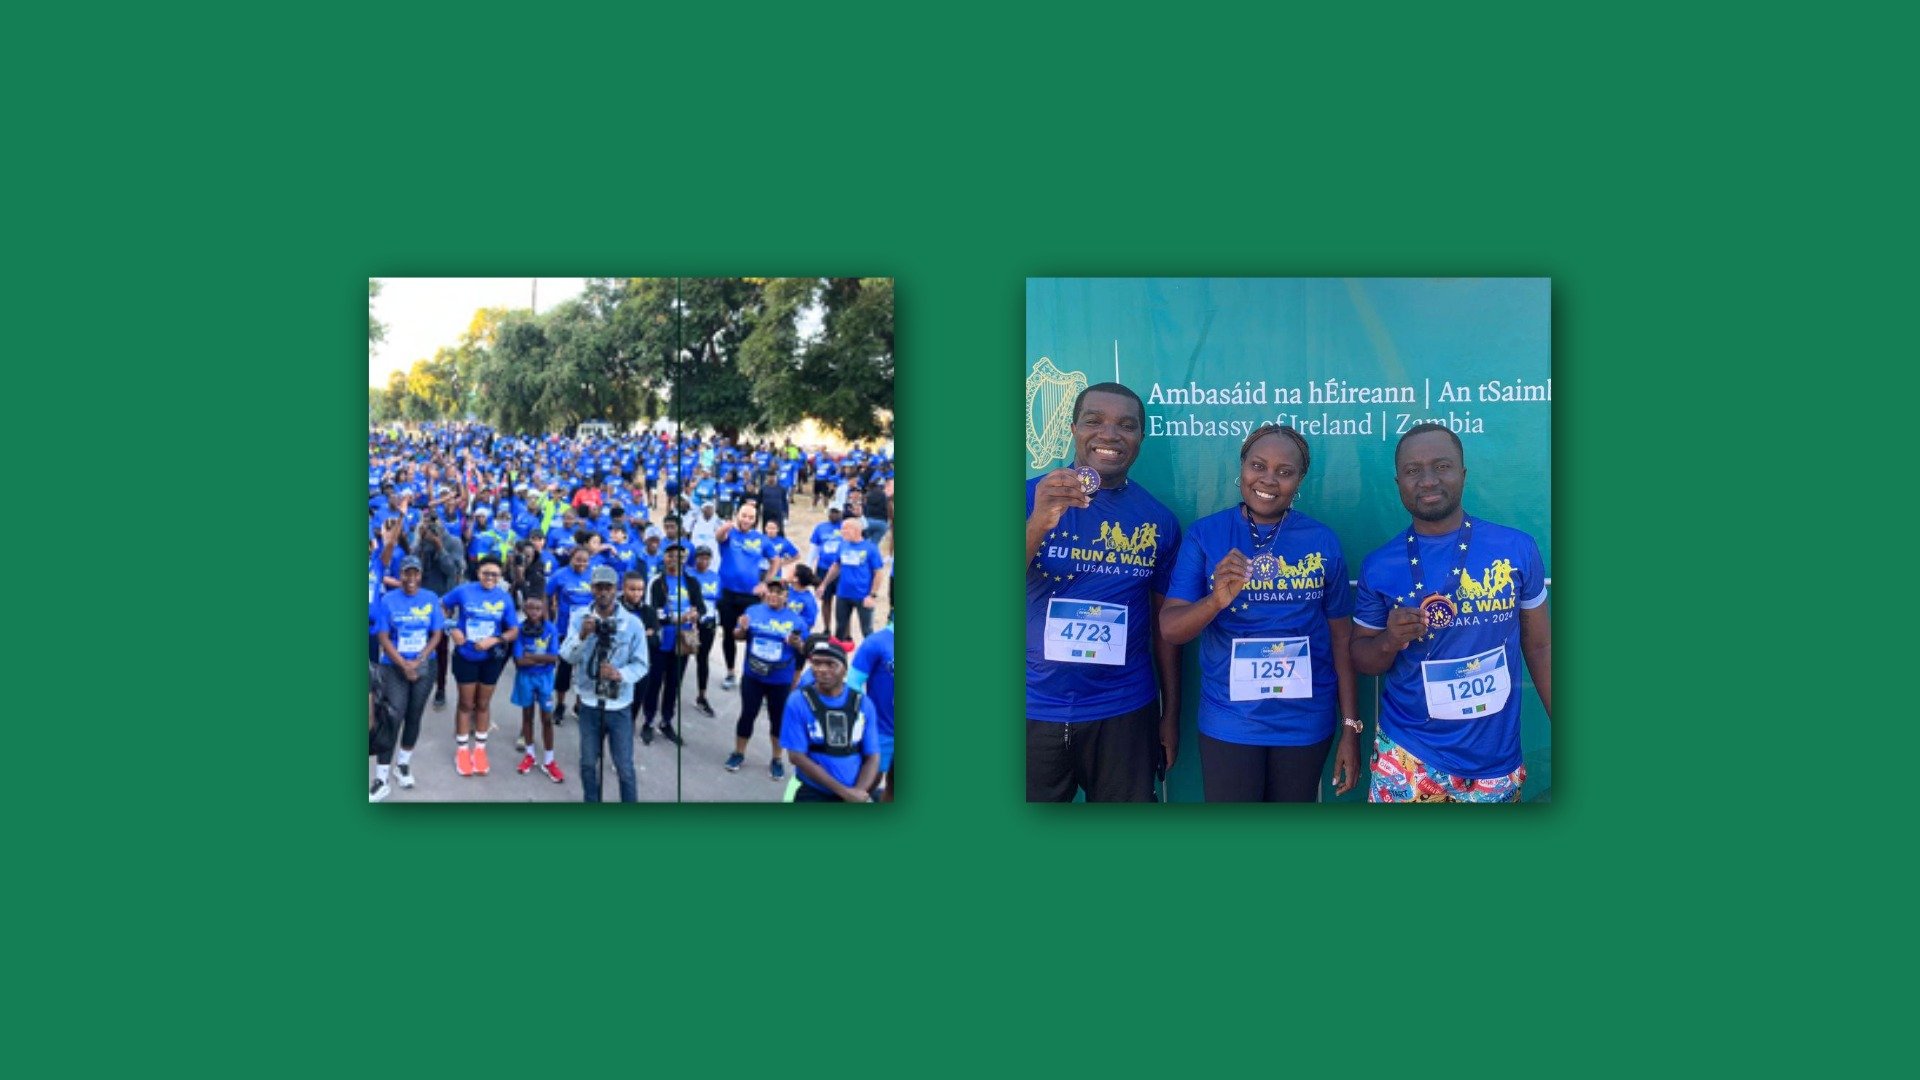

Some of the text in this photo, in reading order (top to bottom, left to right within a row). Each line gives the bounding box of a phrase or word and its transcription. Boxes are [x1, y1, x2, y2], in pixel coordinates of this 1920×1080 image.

[1147, 381, 1267, 405] Ambasáid
[1273, 387, 1302, 404] na
[1308, 378, 1416, 404] hÉireann
[1438, 381, 1472, 402] An
[1149, 413, 1254, 442] Embassy
[1290, 412, 1373, 436] Ireland
[1048, 546, 1155, 567] EU RUN & WALK
[1076, 563, 1121, 575] LUSAKA
[1276, 579, 1288, 590] &
[1248, 592, 1294, 601] LUSAKA
[1461, 601, 1473, 614] &
[1475, 596, 1516, 613] WALK
[1449, 616, 1480, 627] SAKA
[1060, 621, 1112, 643] 4723
[1251, 660, 1296, 679] 1257
[1447, 674, 1497, 701] 1202
